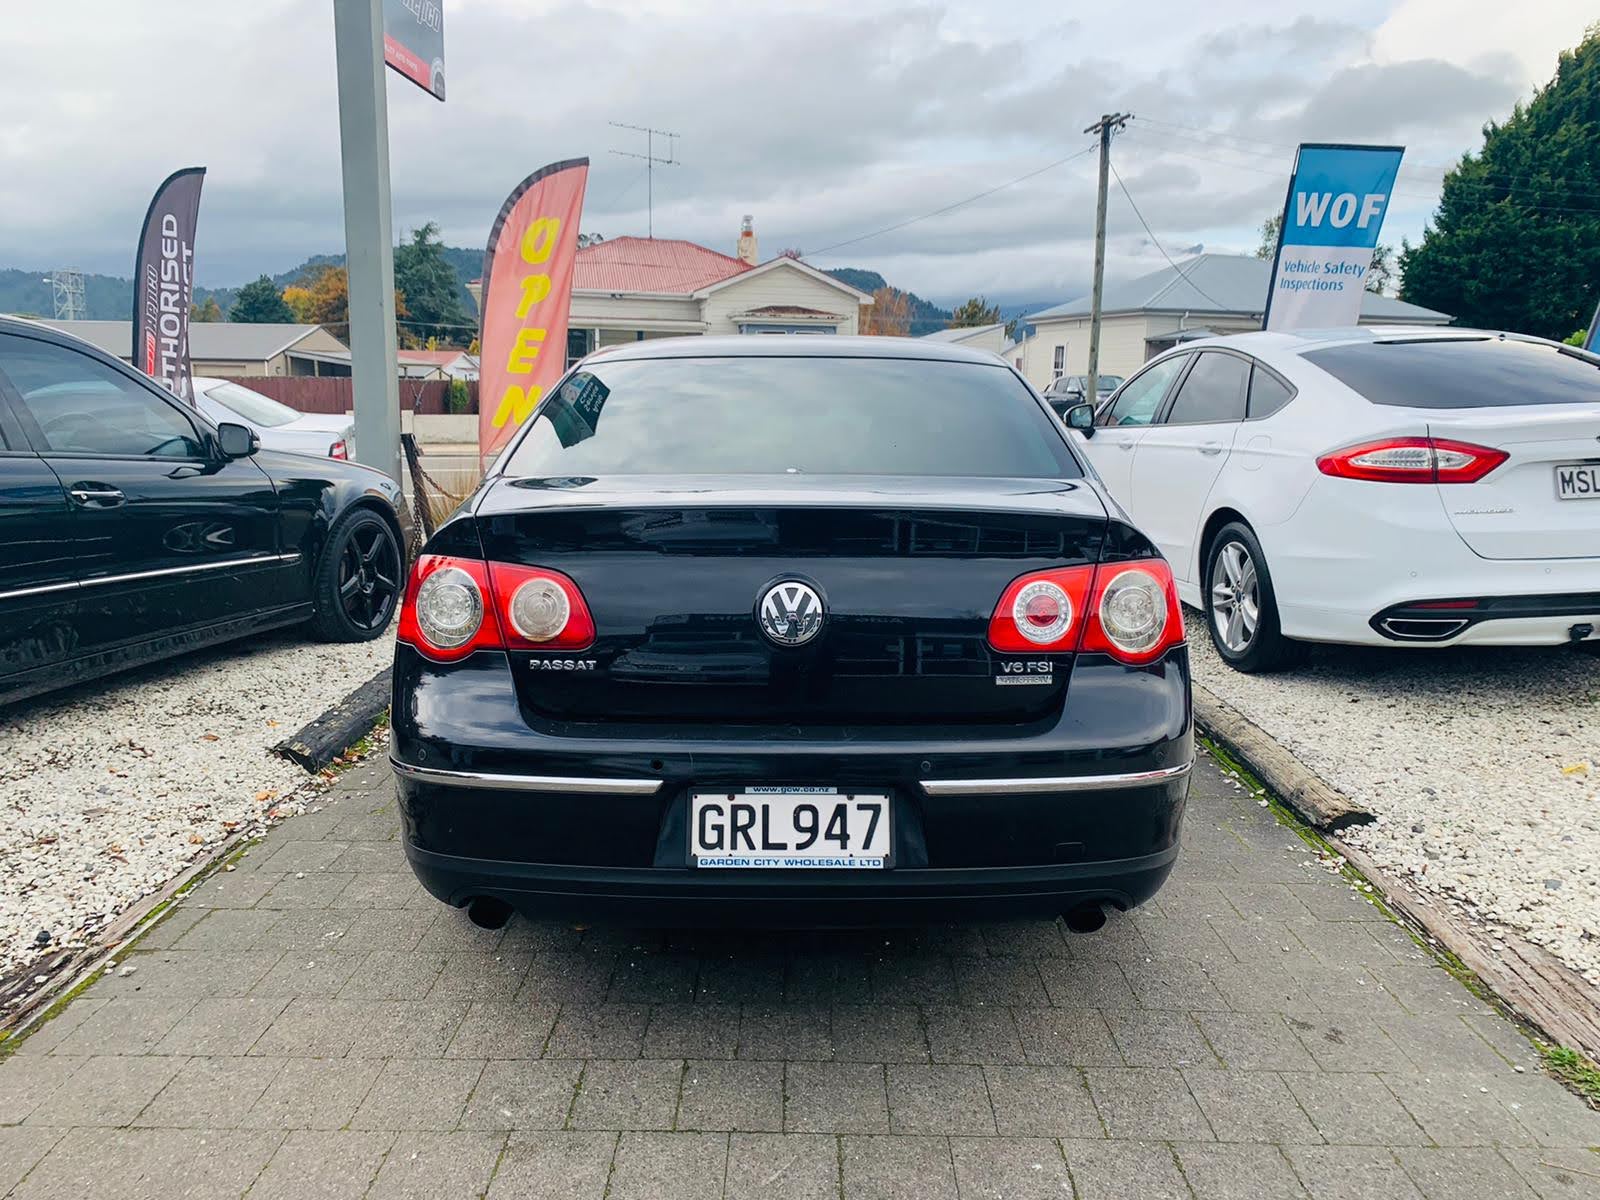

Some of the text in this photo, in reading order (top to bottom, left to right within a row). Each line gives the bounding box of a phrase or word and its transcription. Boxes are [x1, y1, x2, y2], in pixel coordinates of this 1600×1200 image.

[1296, 191, 1386, 229] WOF
[1284, 260, 1366, 278] Vehicle Safety
[1280, 278, 1344, 293] Inspections
[160, 214, 179, 393] UTHORISED
[492, 217, 561, 429] OPEN
[1560, 470, 1600, 494] MSL
[529, 659, 597, 671] PASSAT
[1001, 661, 1053, 673] V6 FSI
[753, 786, 830, 794] www.gcw.co.nz
[698, 803, 882, 851] GRL947
[700, 858, 882, 867] GARDEN CITY WHOLESALE LTD
